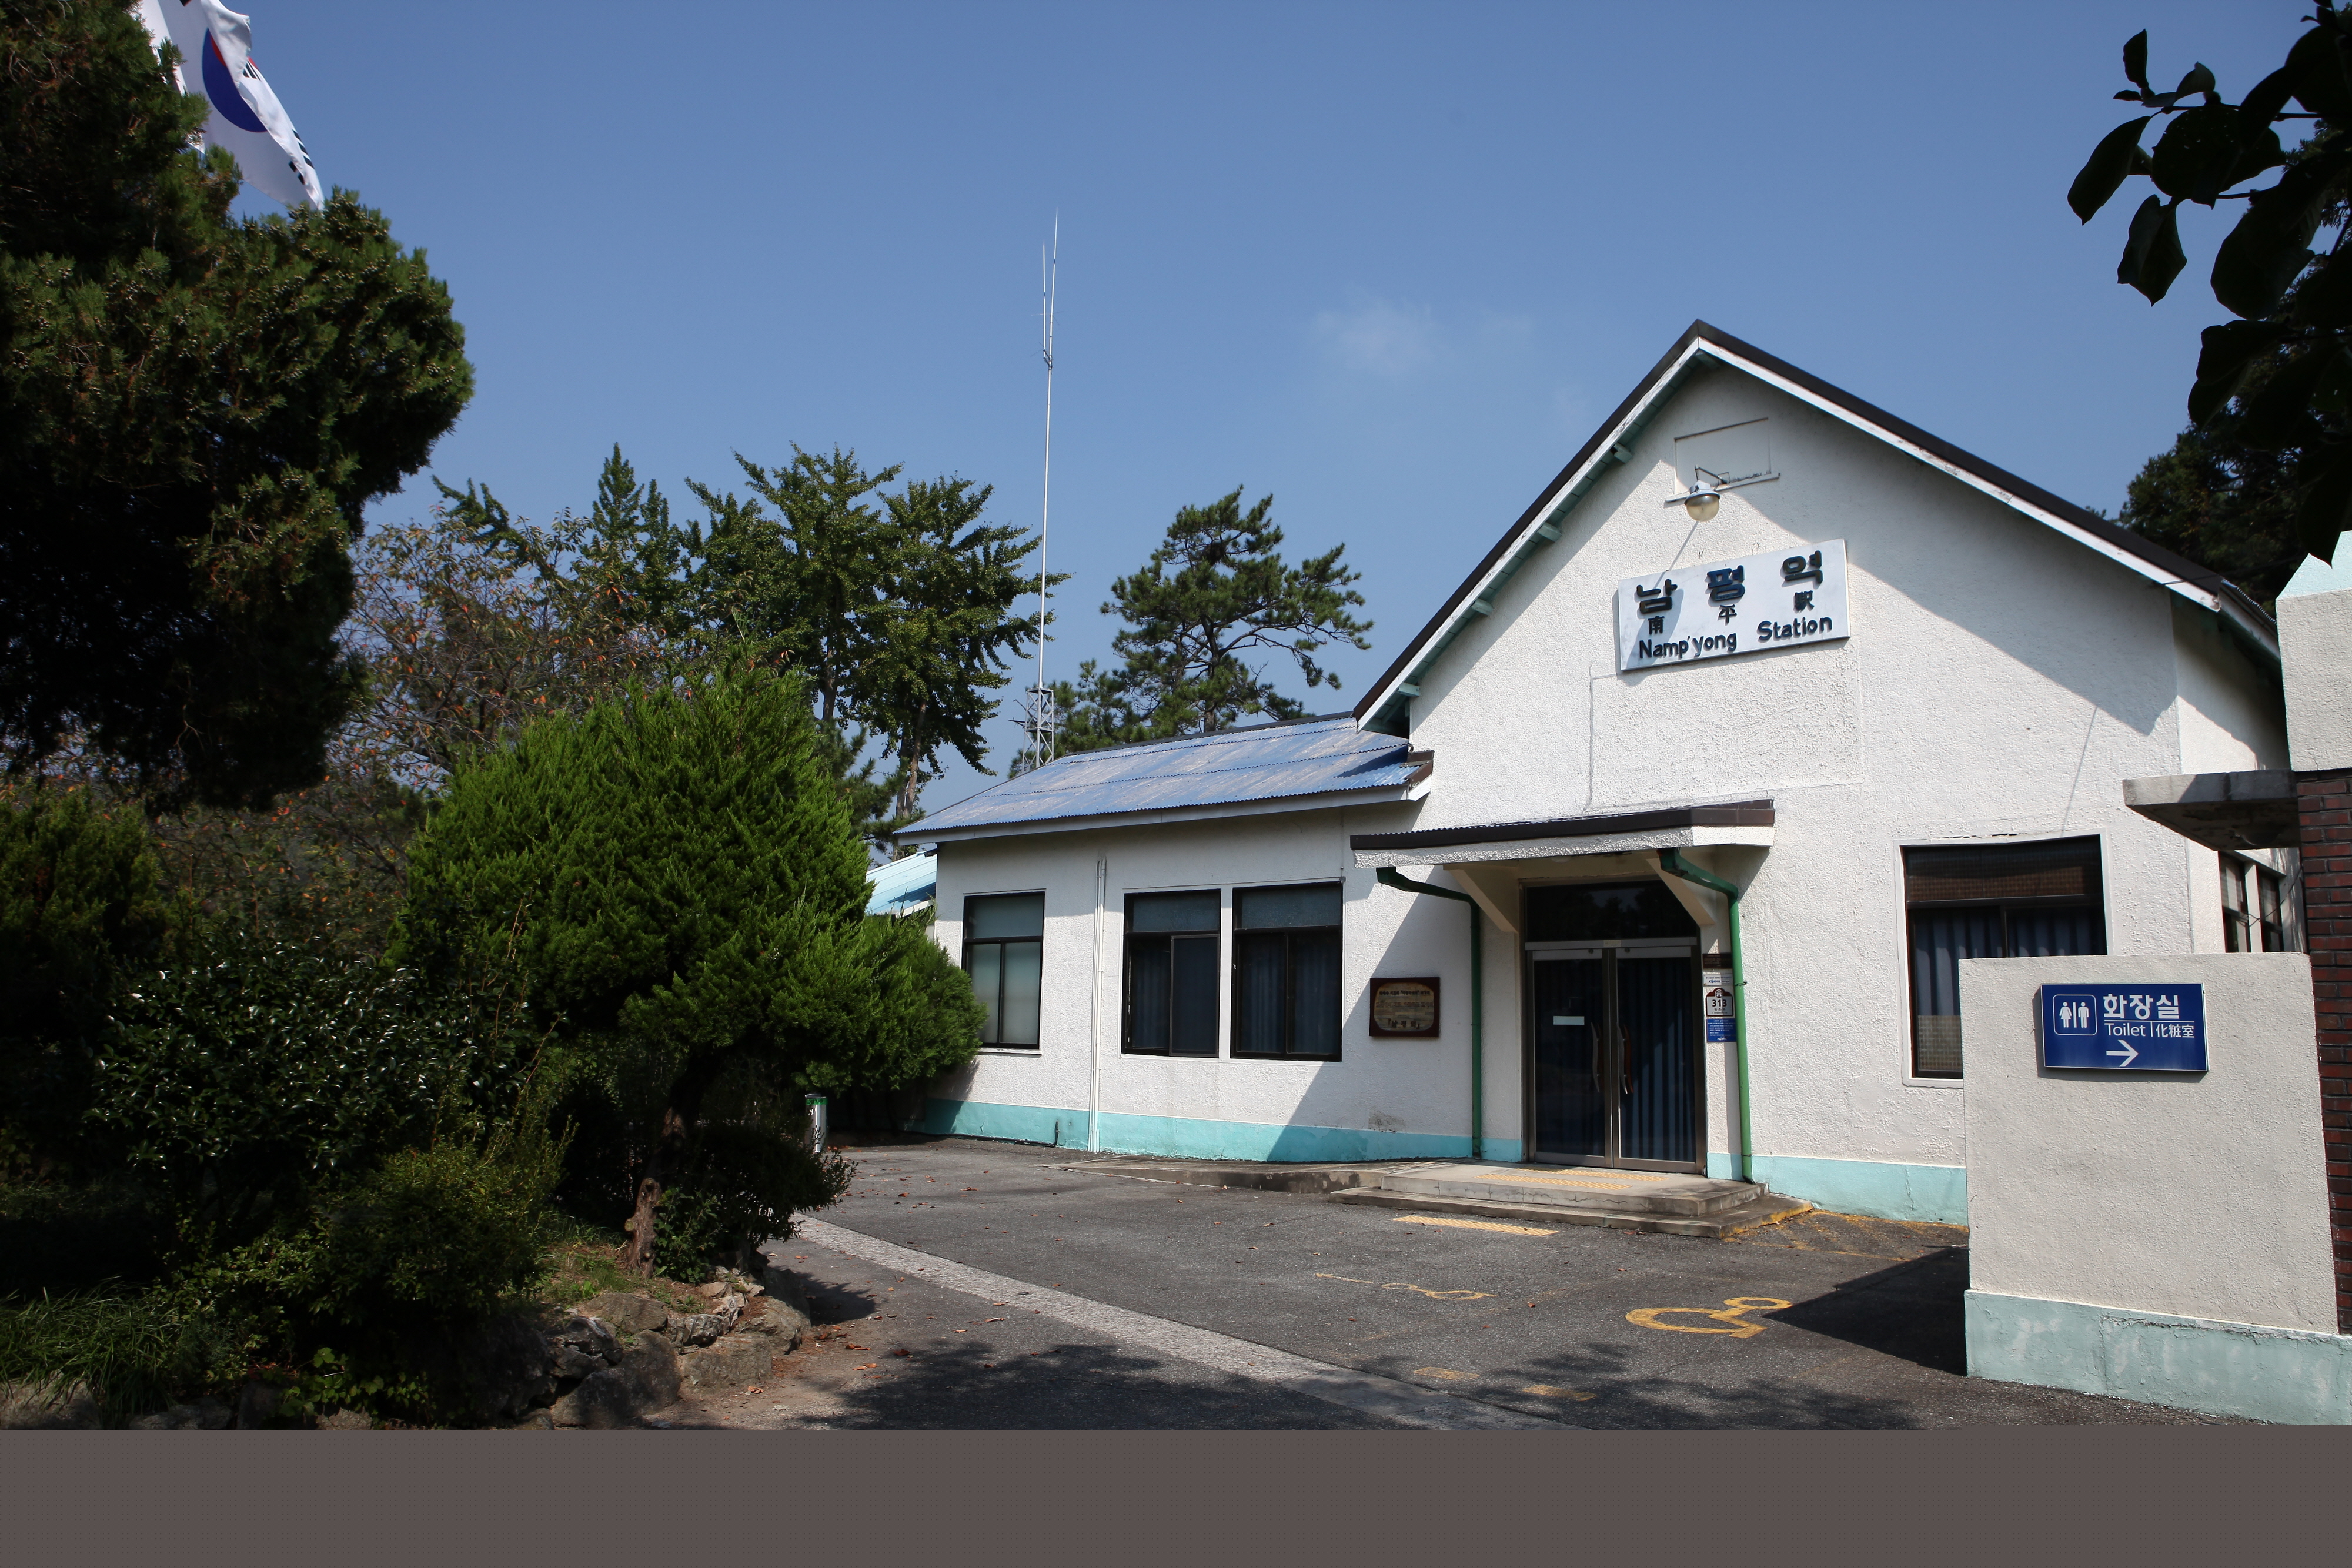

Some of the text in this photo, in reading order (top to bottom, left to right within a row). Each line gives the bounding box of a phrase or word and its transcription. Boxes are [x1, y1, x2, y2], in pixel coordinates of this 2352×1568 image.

[1639, 617, 1832, 659] Namp'yong Station
[2103, 994, 2179, 1019] 화장실
[2104, 1022, 2146, 1037] Toilet
[2156, 1024, 2194, 1038] 化粧室
